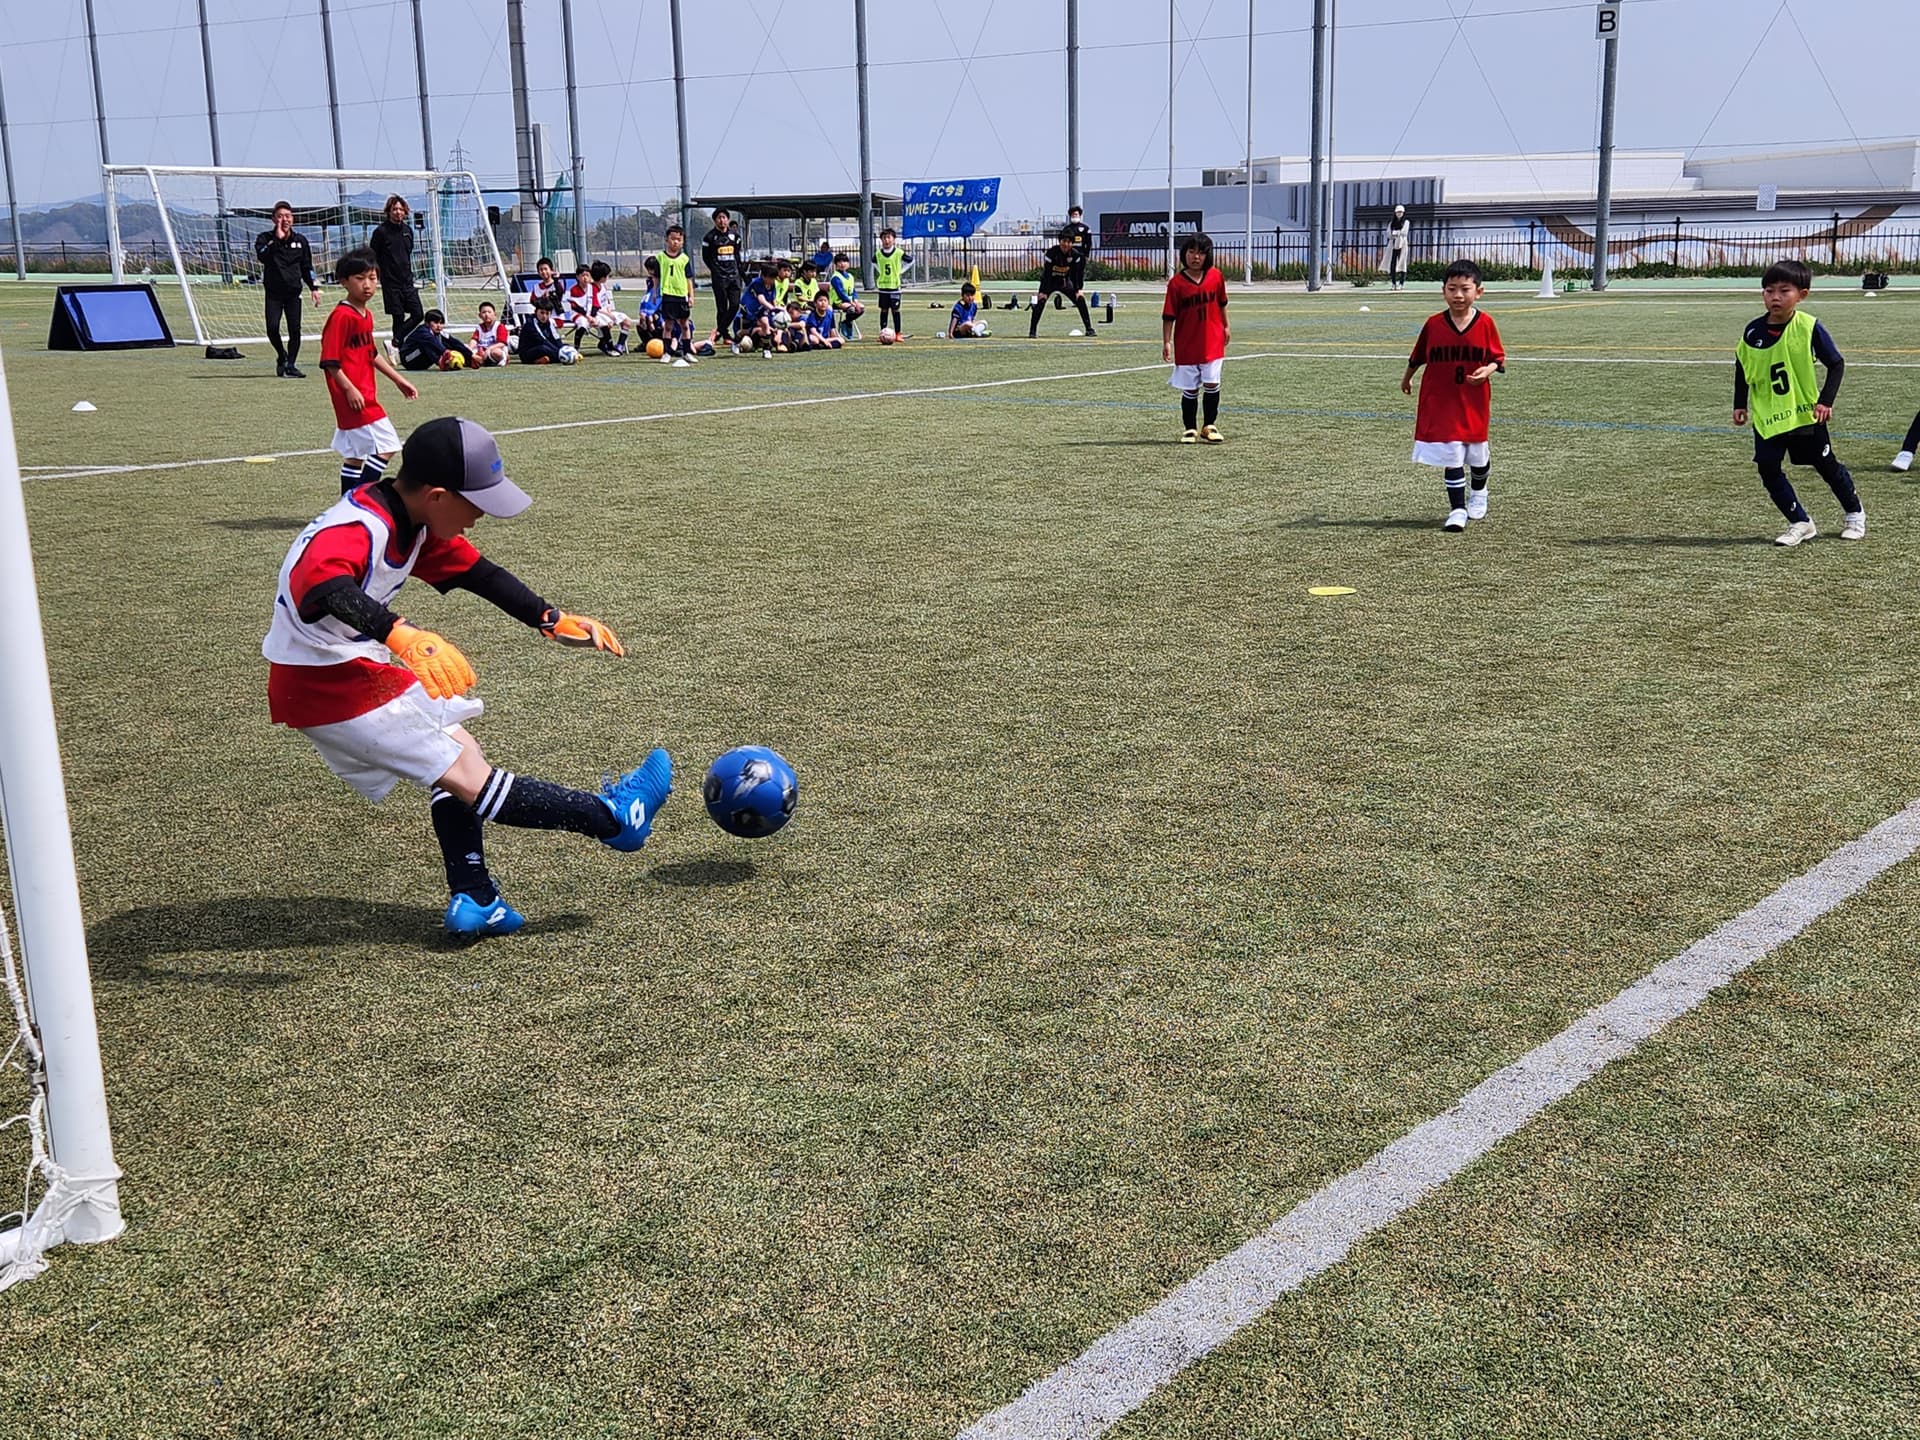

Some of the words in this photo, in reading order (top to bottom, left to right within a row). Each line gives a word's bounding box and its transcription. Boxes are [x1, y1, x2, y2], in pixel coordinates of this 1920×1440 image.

[1599, 10, 1617, 33] B
[928, 185, 965, 198] FC今治
[904, 200, 990, 217] YUMEフェスティバル
[1157, 221, 1198, 237] CIEMA
[884, 263, 892, 276] 5
[1769, 361, 1790, 396] 5
